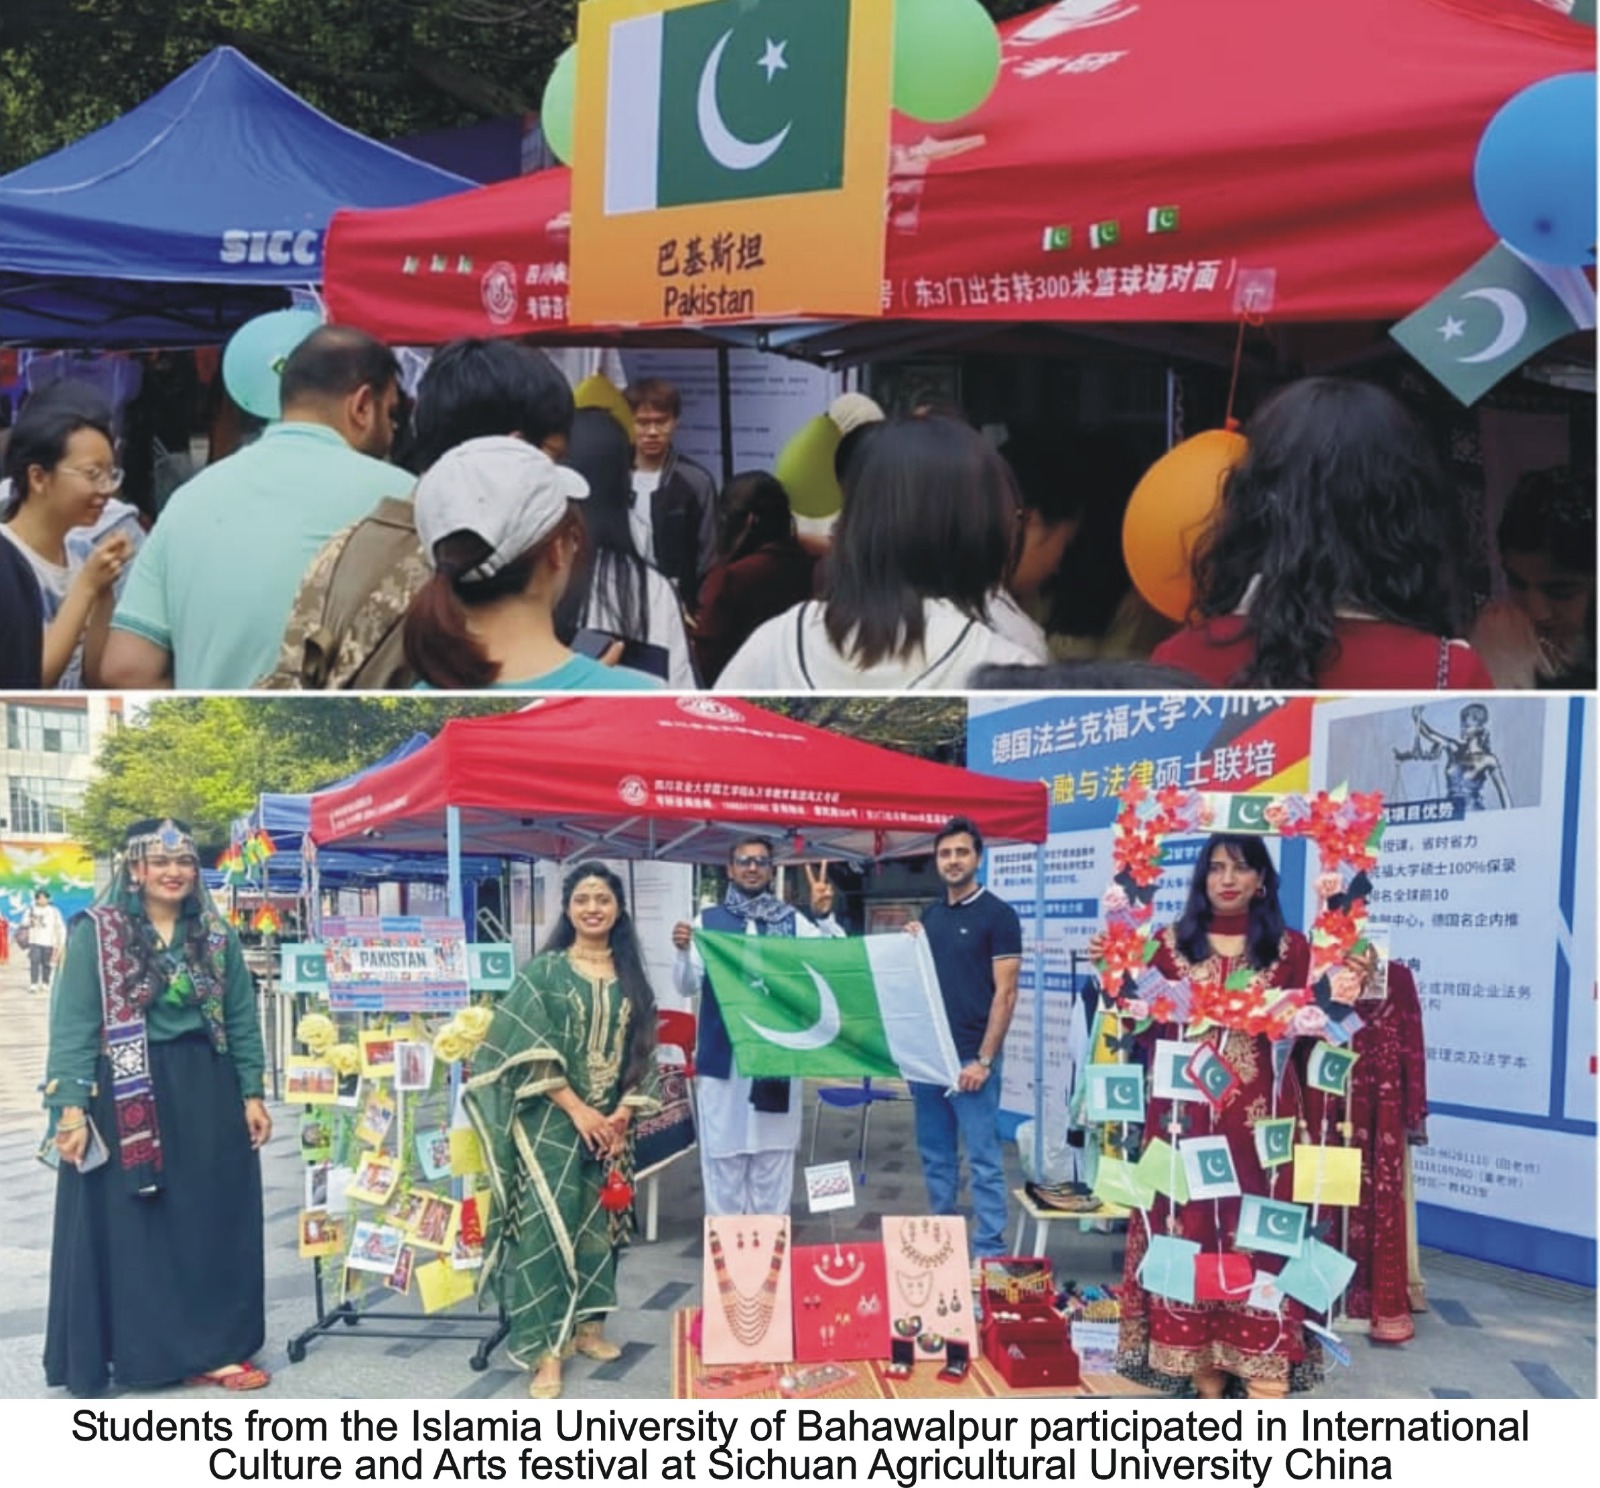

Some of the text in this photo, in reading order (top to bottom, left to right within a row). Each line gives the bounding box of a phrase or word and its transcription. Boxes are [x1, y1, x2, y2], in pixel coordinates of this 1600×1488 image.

[220, 230, 319, 265] SICC
[658, 232, 765, 277] 巴基斯坦
[664, 283, 754, 318] Pakistan
[1039, 740, 1276, 806] 融与法律硕士联培
[1384, 801, 1454, 823] 项目优势
[1376, 834, 1478, 854] 授课，省时省力
[360, 950, 427, 968] PAKISTAN
